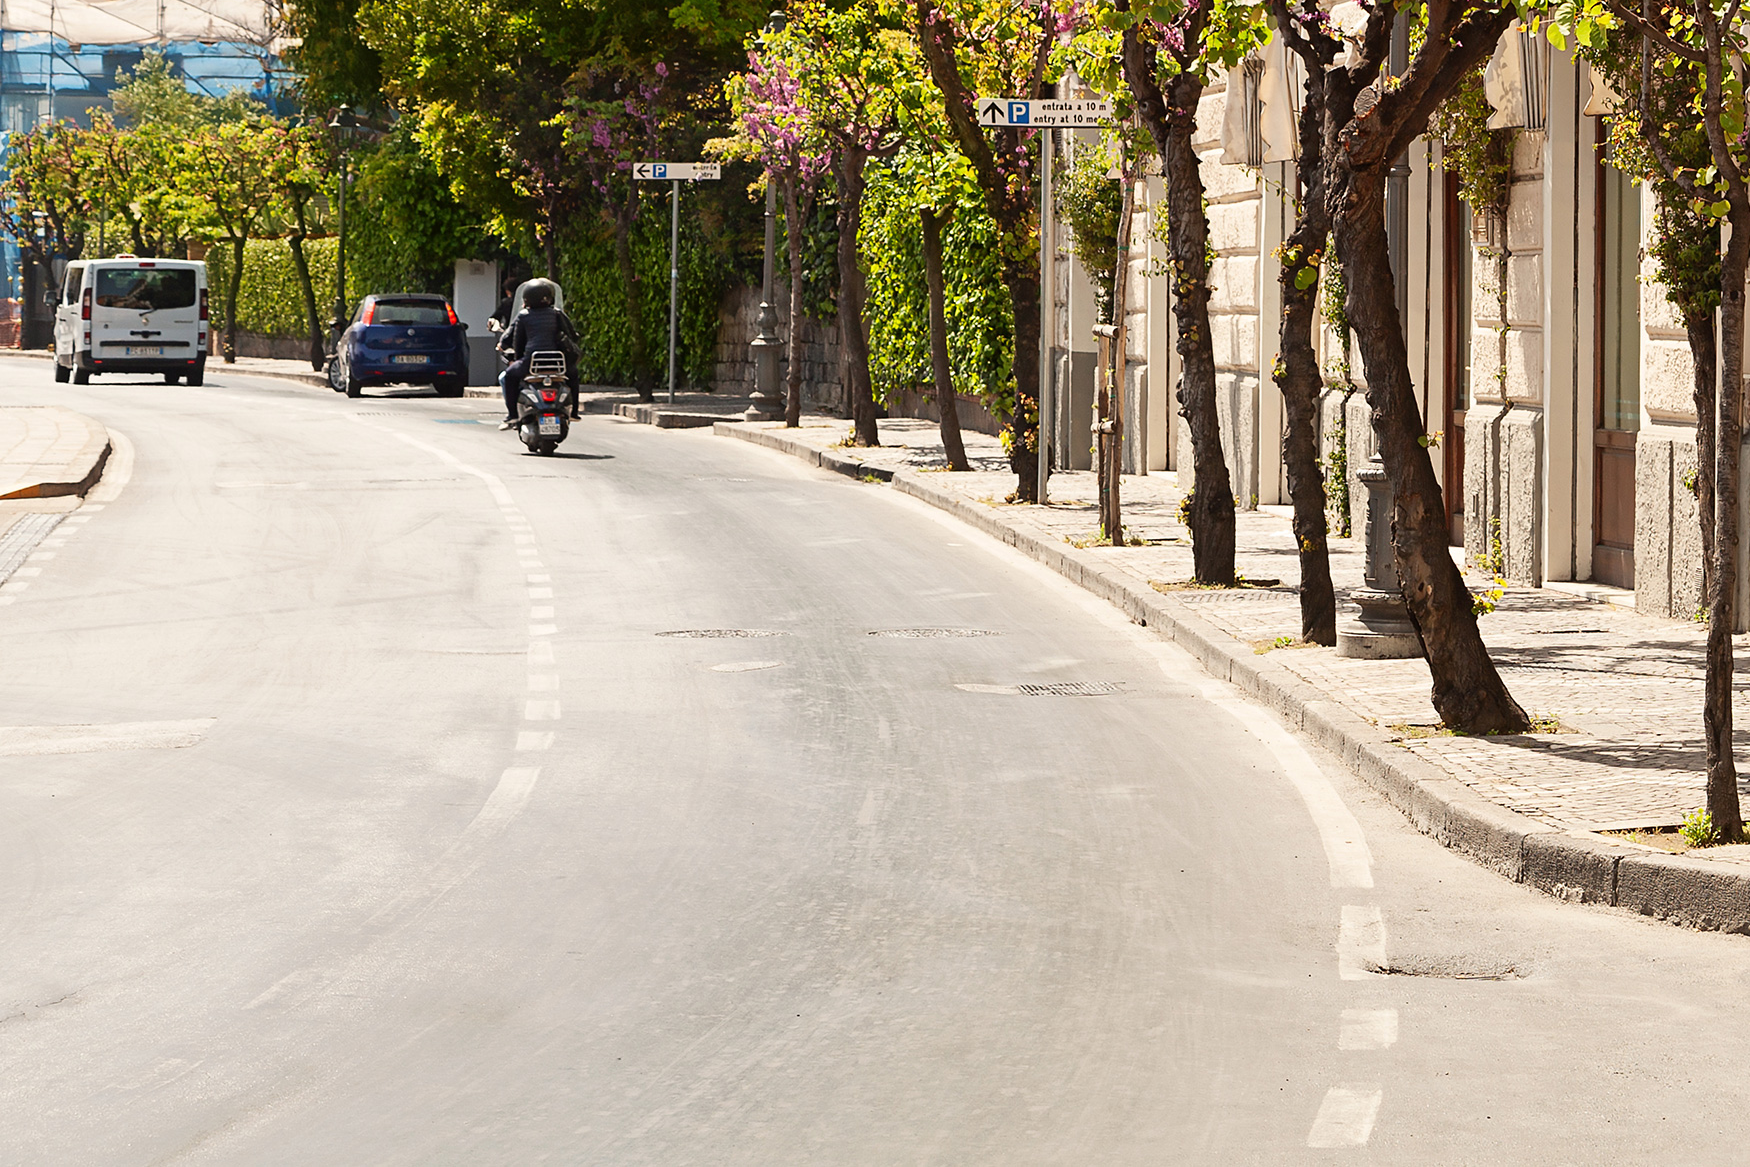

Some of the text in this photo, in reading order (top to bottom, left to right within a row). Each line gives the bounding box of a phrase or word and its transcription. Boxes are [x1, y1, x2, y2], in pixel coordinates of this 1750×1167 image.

[1041, 102, 1073, 111] entrata
[1086, 102, 1096, 111] 10
[1012, 103, 1027, 123] P
[1033, 114, 1056, 125] entry
[1060, 115, 1069, 123] at
[1073, 114, 1083, 123] 10
